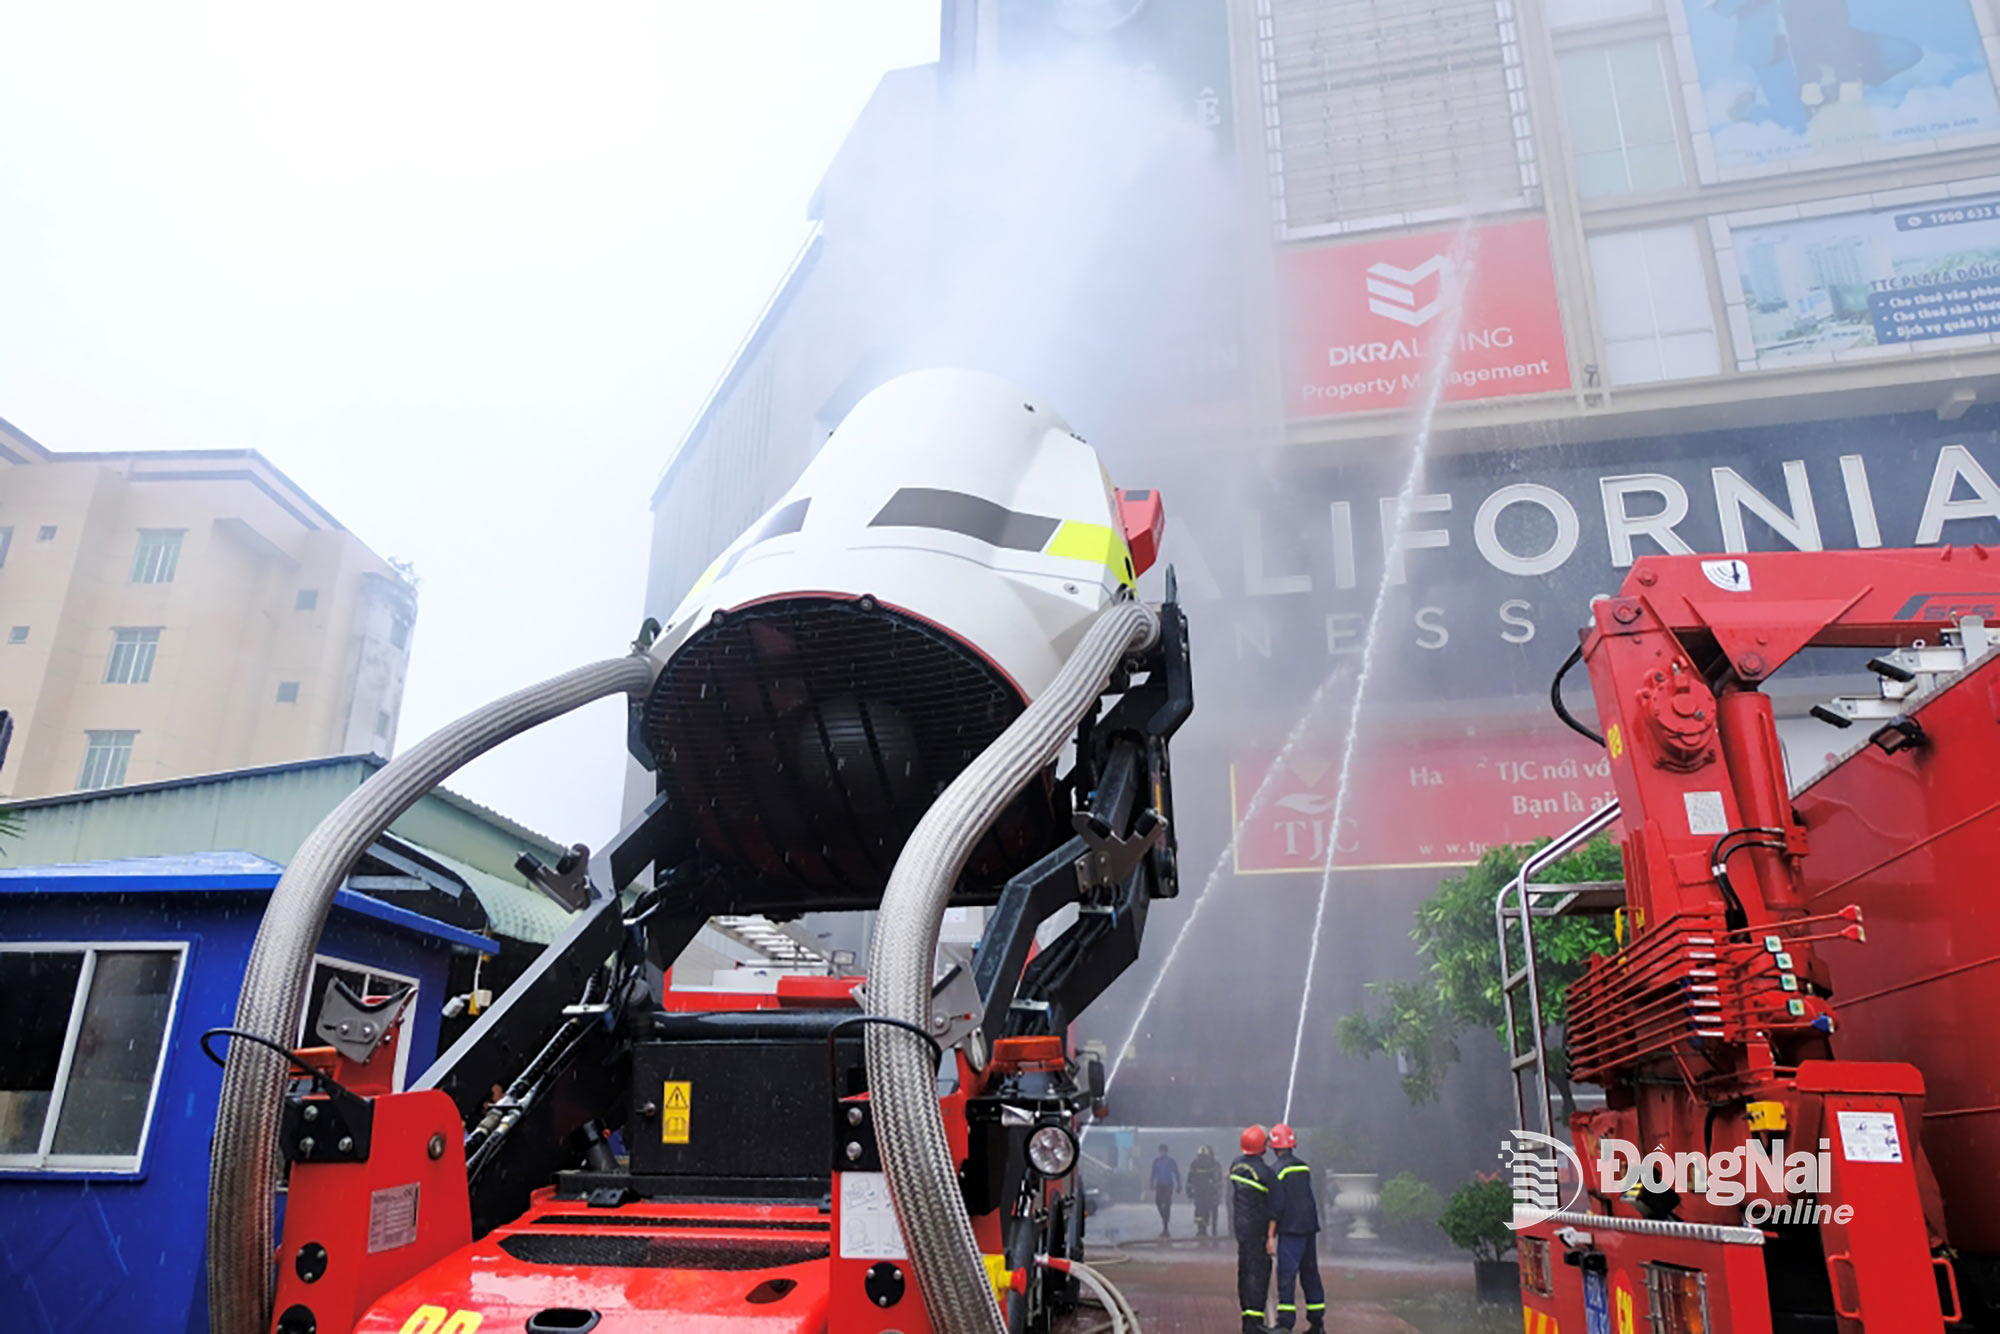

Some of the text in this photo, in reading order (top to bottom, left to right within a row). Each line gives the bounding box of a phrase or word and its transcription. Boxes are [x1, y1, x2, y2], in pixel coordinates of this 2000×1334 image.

[1901, 271, 1952, 287] PLAZA
[1889, 297, 1912, 308] Cho
[1893, 311, 1916, 322] Cho
[1328, 327, 1514, 367] DKRALING
[1303, 359, 1549, 400] Property Magement
[1495, 760, 1538, 784] TJC
[1512, 794, 1560, 819] Bạn
[1563, 791, 1585, 812] là
[1274, 817, 1359, 861] TJC
